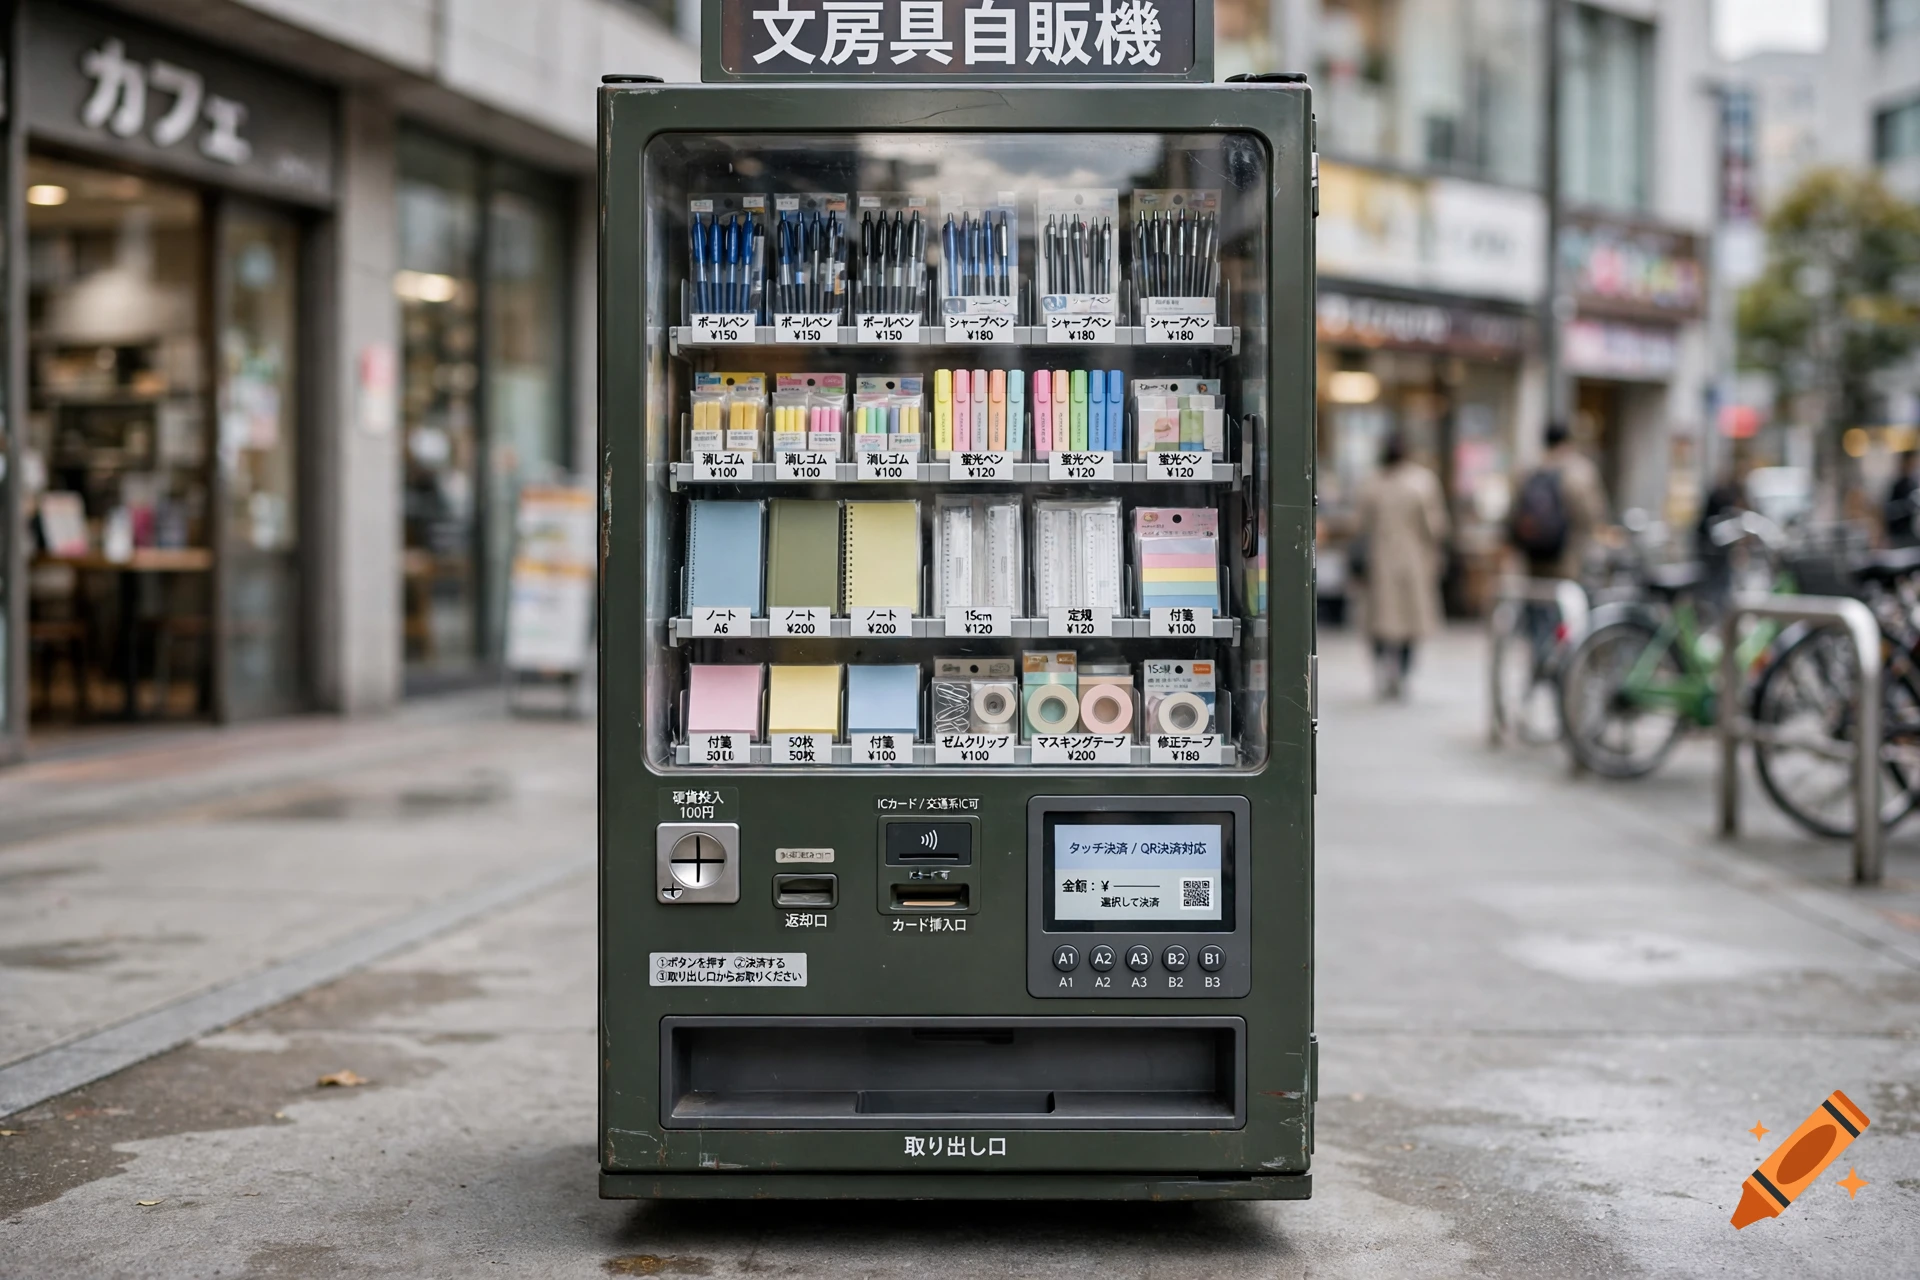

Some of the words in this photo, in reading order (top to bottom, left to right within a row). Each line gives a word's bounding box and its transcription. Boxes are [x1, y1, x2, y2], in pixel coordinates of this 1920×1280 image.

[753, 0, 1161, 66] 文房具自販機
[81, 37, 252, 166] カフェ
[698, 316, 749, 328] ボールペン
[782, 316, 832, 328] ボールペン
[864, 316, 914, 328] ボールペン
[711, 330, 737, 340] ¥150
[794, 330, 820, 340] ¥150
[876, 331, 902, 341] ¥150
[967, 330, 993, 340] ¥180
[1069, 330, 1095, 340] ¥180
[1167, 331, 1193, 341] ¥180
[703, 453, 744, 465] 消しゴム
[785, 453, 827, 465] 消しゴム
[867, 453, 909, 465] 消しゴム
[710, 467, 737, 477] ¥100
[793, 468, 820, 478] ¥100
[875, 467, 902, 477] ¥100
[968, 468, 995, 478] ¥120
[1068, 468, 1095, 478] ¥120
[1167, 468, 1193, 478] ¥120
[707, 610, 736, 621] ノート
[786, 610, 815, 621] ノート
[867, 610, 896, 621] ノート
[966, 610, 991, 621] 15cm
[1068, 609, 1093, 621] 定規
[714, 623, 728, 633] A6
[787, 624, 815, 634] ¥200
[868, 624, 896, 634] ¥200
[965, 624, 992, 634] ¥120
[1067, 624, 1094, 634] ¥120
[1168, 624, 1195, 634] ¥100
[942, 736, 1009, 748] ゼムクリップ
[1038, 736, 1125, 748] マスキングテープ
[1158, 736, 1214, 748] 修正テープ
[868, 751, 896, 761] ¥100
[961, 751, 989, 761] ¥100
[1068, 751, 1095, 761] ¥200
[673, 790, 723, 804] 硬貨投入
[878, 798, 917, 809] ICカード
[681, 806, 713, 819] 100円
[1070, 843, 1127, 854] タッチ決済
[1141, 842, 1206, 855] QR決済対応
[1101, 897, 1159, 907] 選択して決済
[786, 913, 826, 927] 返却口
[893, 917, 966, 932] カード挿入口
[1058, 953, 1074, 964] A1
[1094, 953, 1112, 964] A2
[1131, 953, 1148, 964] A3
[1168, 953, 1185, 964] B2
[1205, 953, 1220, 964] B1
[1059, 977, 1072, 987] A1
[1095, 977, 1110, 987] A2
[1132, 977, 1147, 987] A3
[1169, 977, 1183, 987] B2
[1205, 977, 1220, 987] B3
[904, 1136, 1005, 1156] 取り出し口
